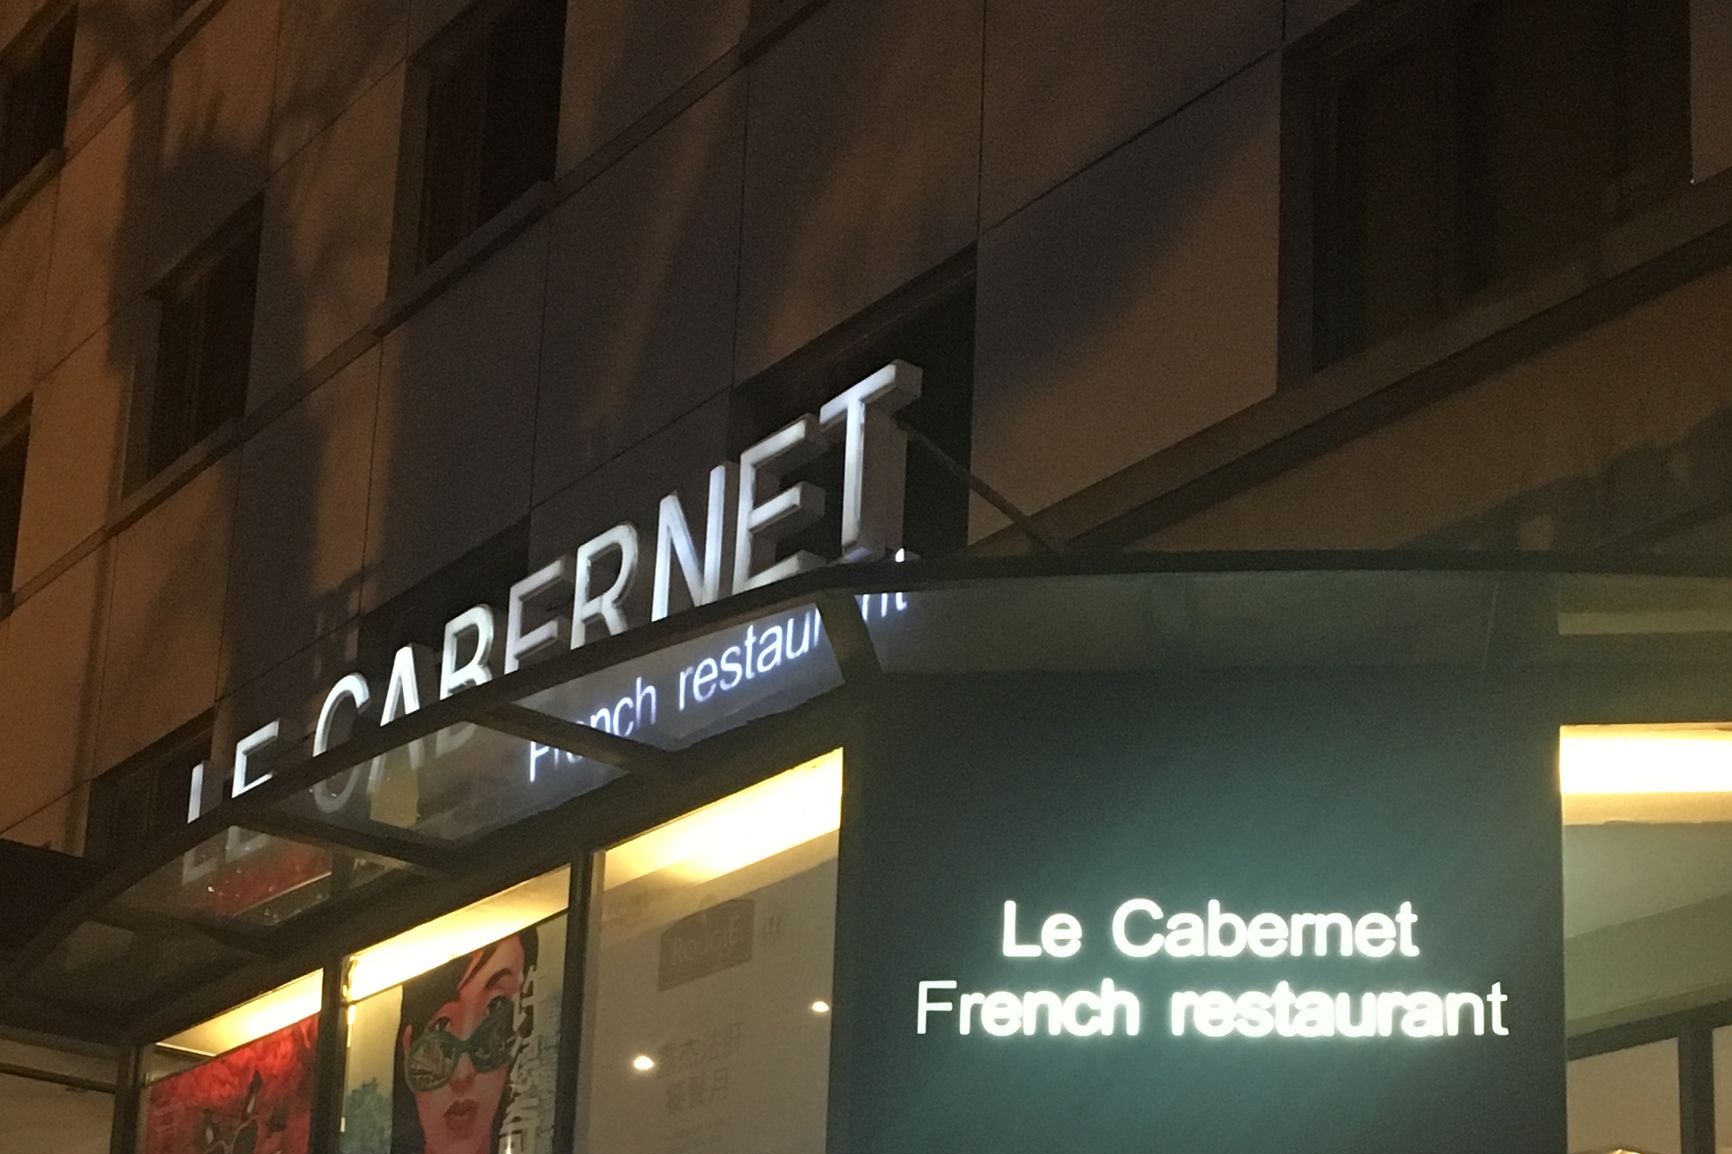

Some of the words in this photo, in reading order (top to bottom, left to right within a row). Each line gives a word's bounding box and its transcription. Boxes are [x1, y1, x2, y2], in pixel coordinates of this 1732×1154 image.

[182, 719, 281, 880] LE
[311, 359, 920, 814] CABERNET
[677, 549, 909, 712] restaunt
[1001, 899, 1083, 958] Le
[1111, 898, 1421, 958] Cabernet
[916, 978, 1141, 1036] French
[1170, 980, 1510, 1037] restaurant
